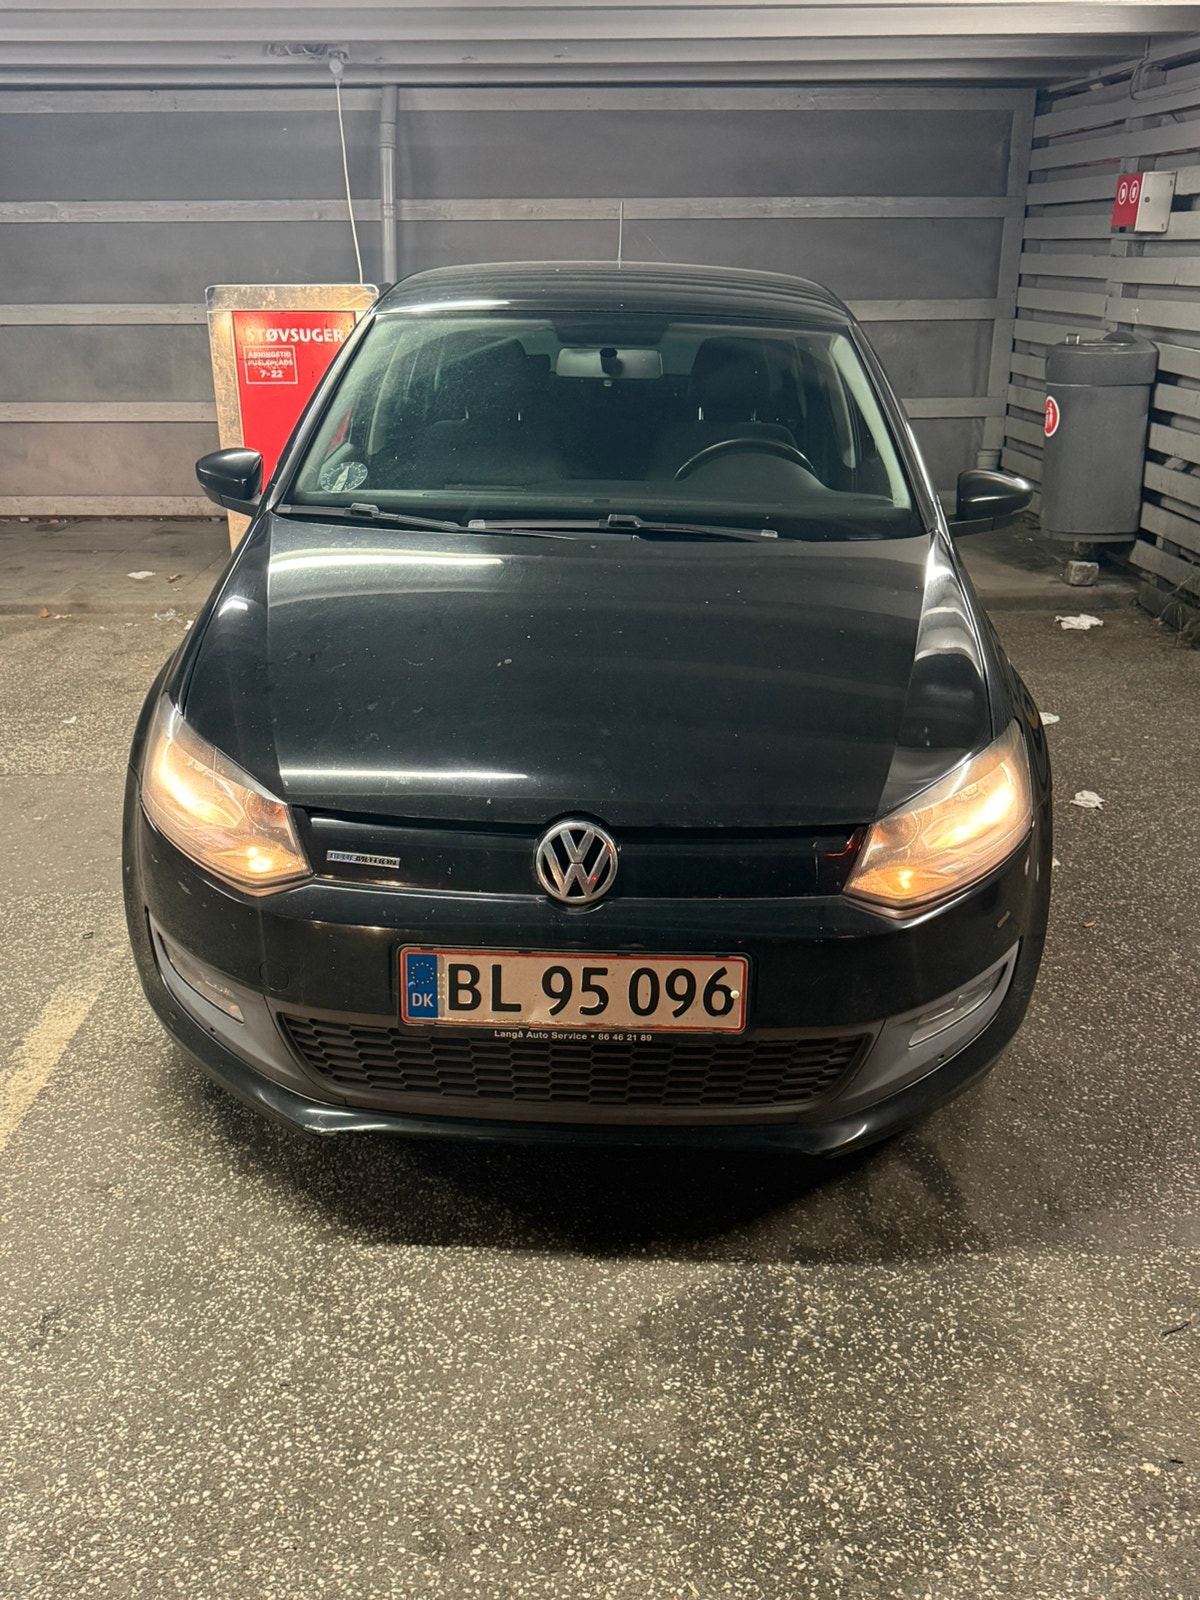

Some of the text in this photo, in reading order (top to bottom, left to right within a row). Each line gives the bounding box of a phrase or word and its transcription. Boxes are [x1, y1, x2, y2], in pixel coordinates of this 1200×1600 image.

[246, 328, 344, 343] STØVSUGER
[260, 370, 283, 379] 7-22
[448, 963, 738, 1019] BL 95 096
[411, 993, 434, 1008] DK
[494, 1029, 653, 1042] Langå Auto Service 86 46 21 89
